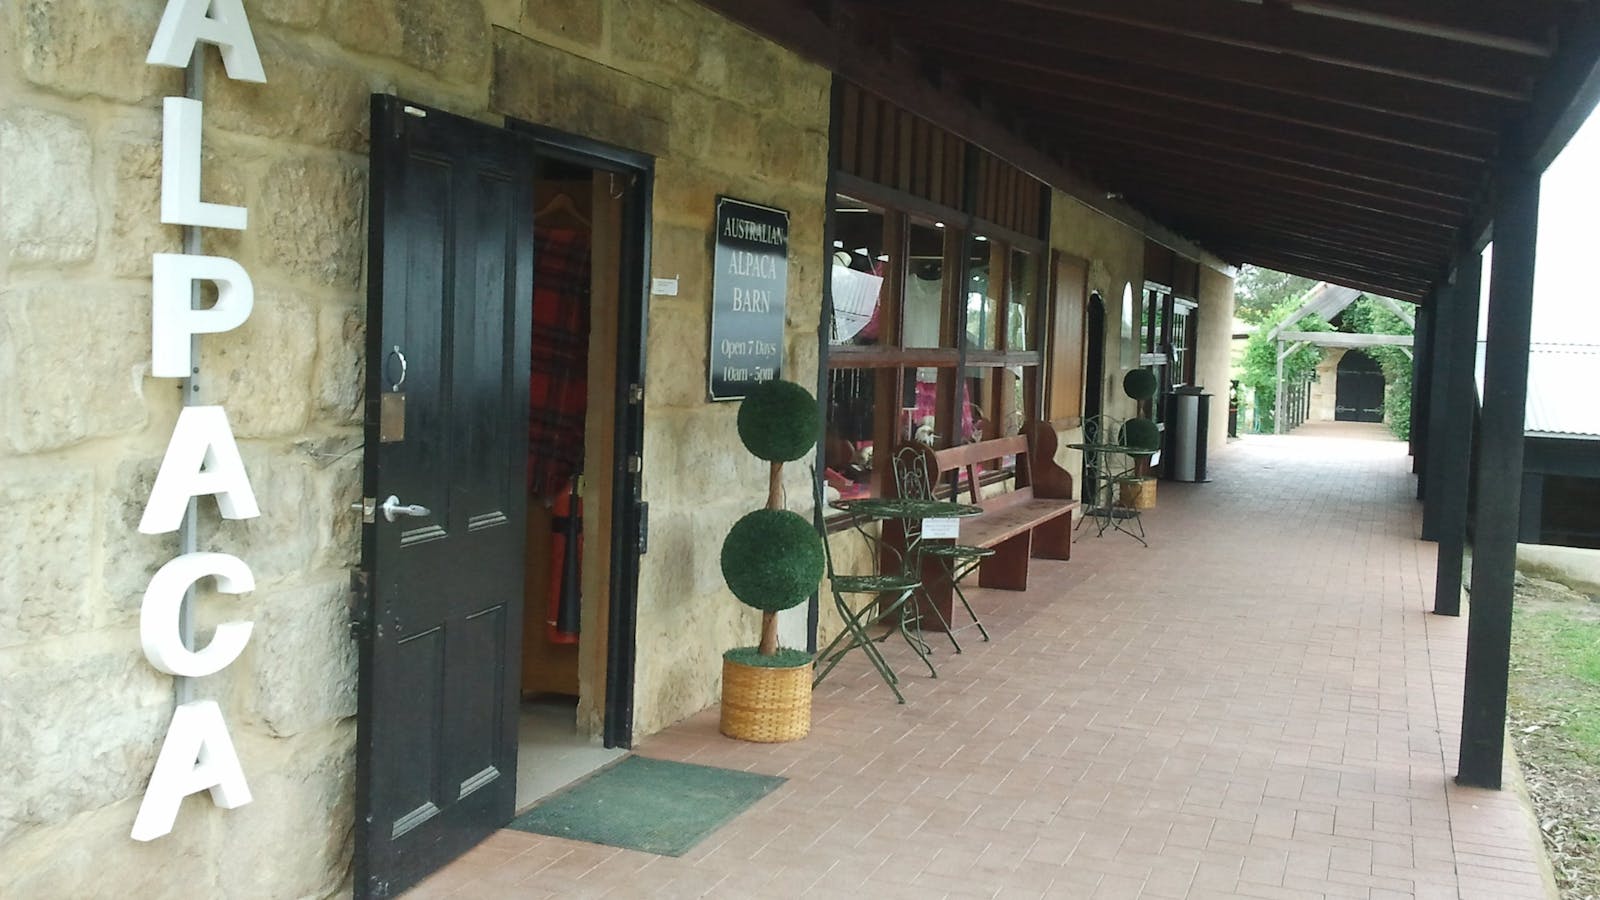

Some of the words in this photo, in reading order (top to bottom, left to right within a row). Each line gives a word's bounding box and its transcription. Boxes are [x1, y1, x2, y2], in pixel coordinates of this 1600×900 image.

[723, 216, 784, 246] AUSTRALIAN
[728, 251, 776, 280] ALPACA
[732, 287, 771, 313] BARN
[721, 338, 747, 360] Open
[747, 340, 754, 355] 7
[755, 340, 777, 360] Days
[723, 365, 748, 382] 10am
[131, 0, 267, 841] ALPACA
